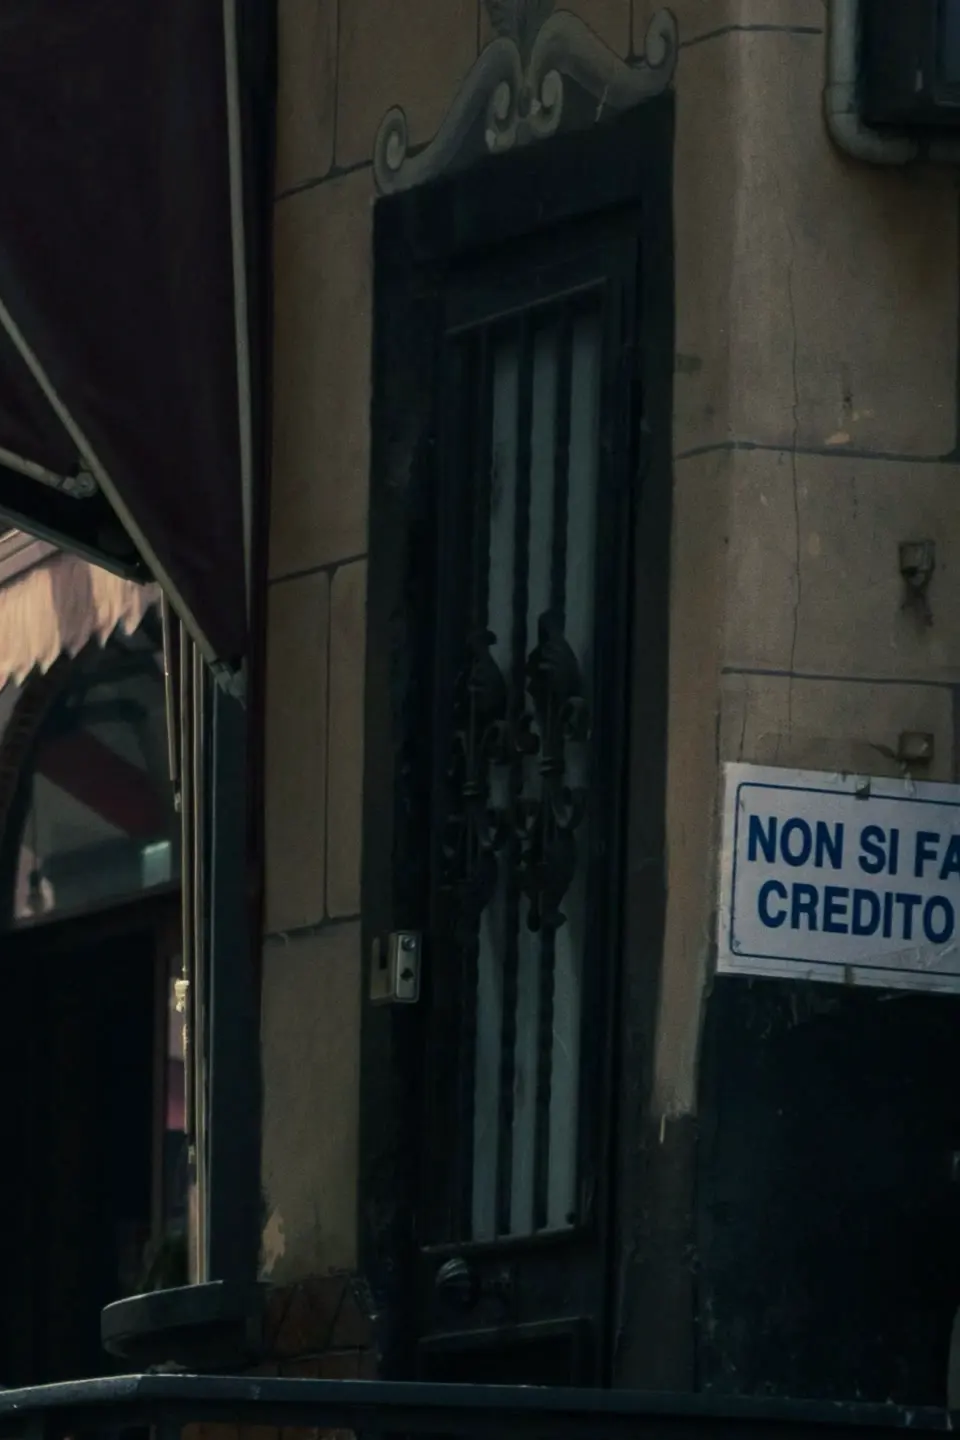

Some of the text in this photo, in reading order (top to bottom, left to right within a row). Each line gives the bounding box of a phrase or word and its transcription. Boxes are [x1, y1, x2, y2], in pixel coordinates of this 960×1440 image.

[747, 814, 844, 869] NON
[858, 825, 899, 875] SI
[758, 879, 955, 944] CREDITO
